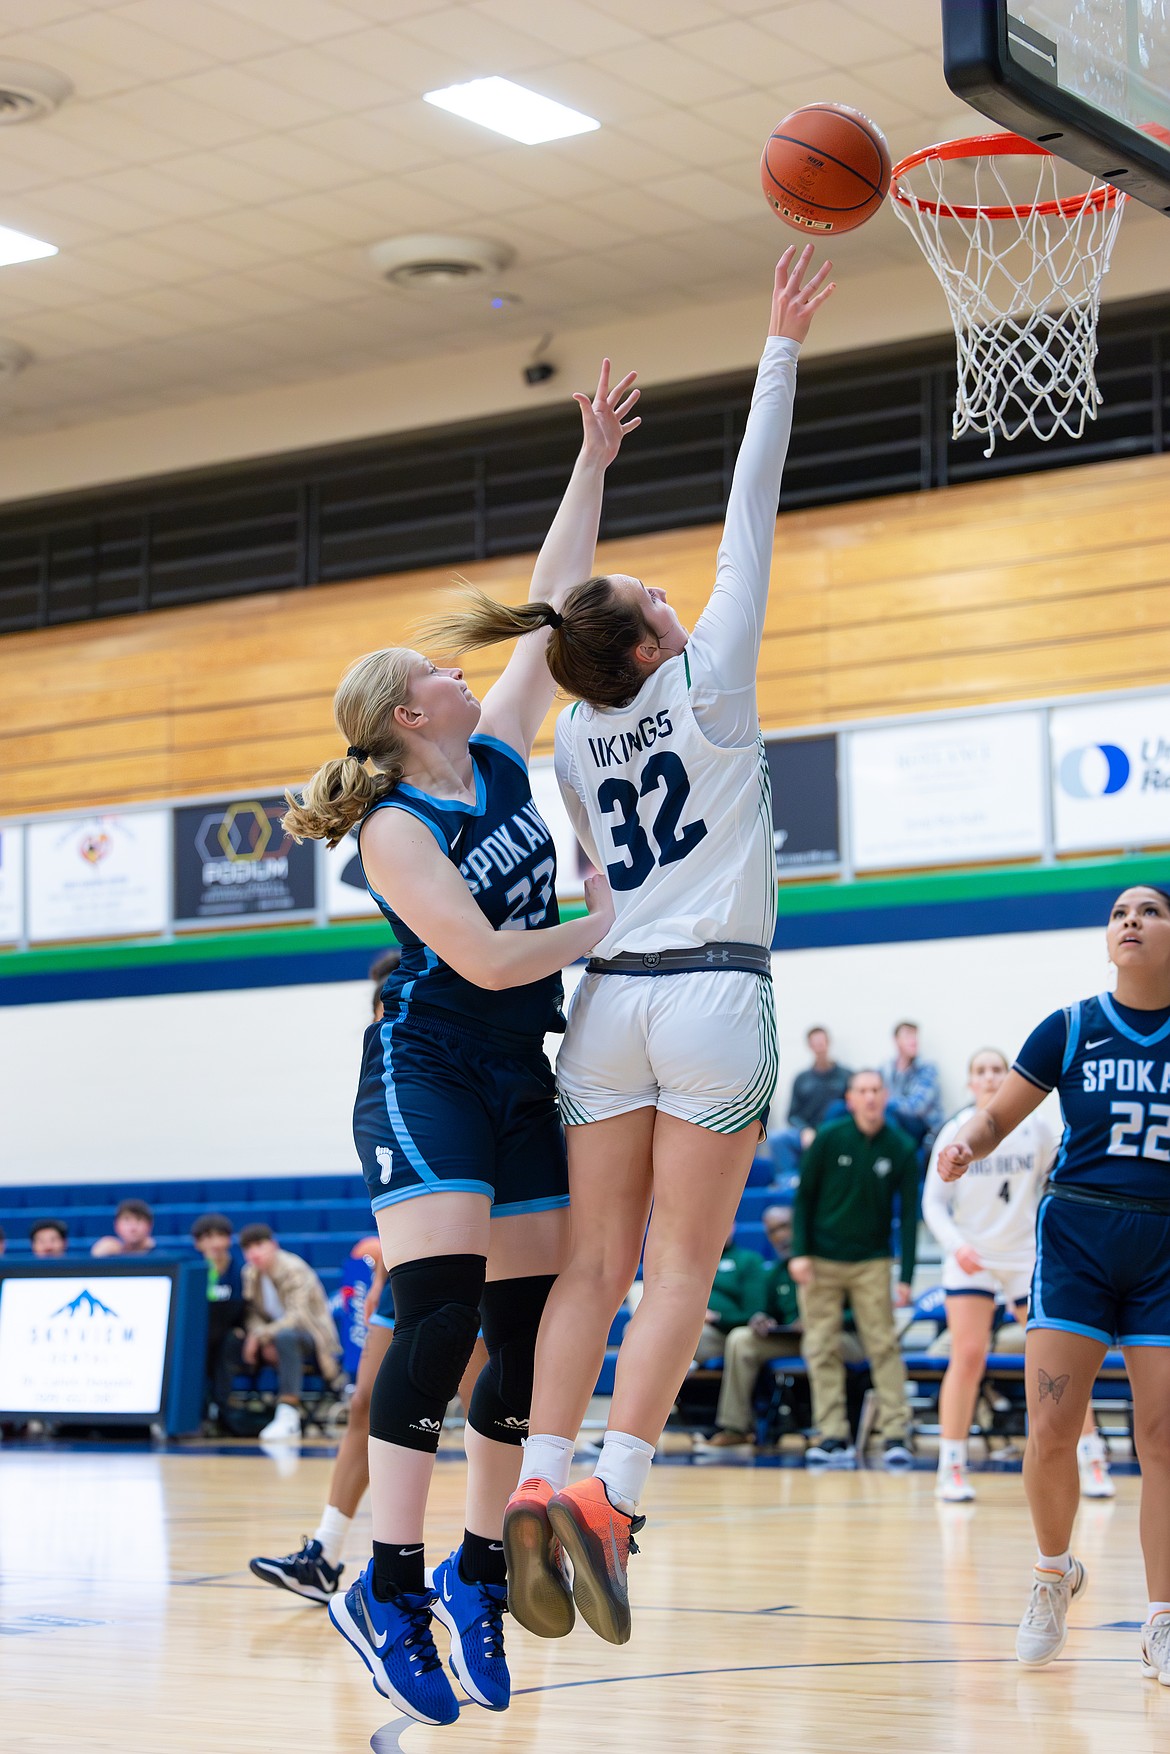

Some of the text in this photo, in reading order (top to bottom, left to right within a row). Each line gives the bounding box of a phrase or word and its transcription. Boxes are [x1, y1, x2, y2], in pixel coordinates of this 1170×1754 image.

[597, 751, 708, 891] 32
[1106, 1100, 1170, 1162] 22
[998, 1178, 1012, 1204] 4
